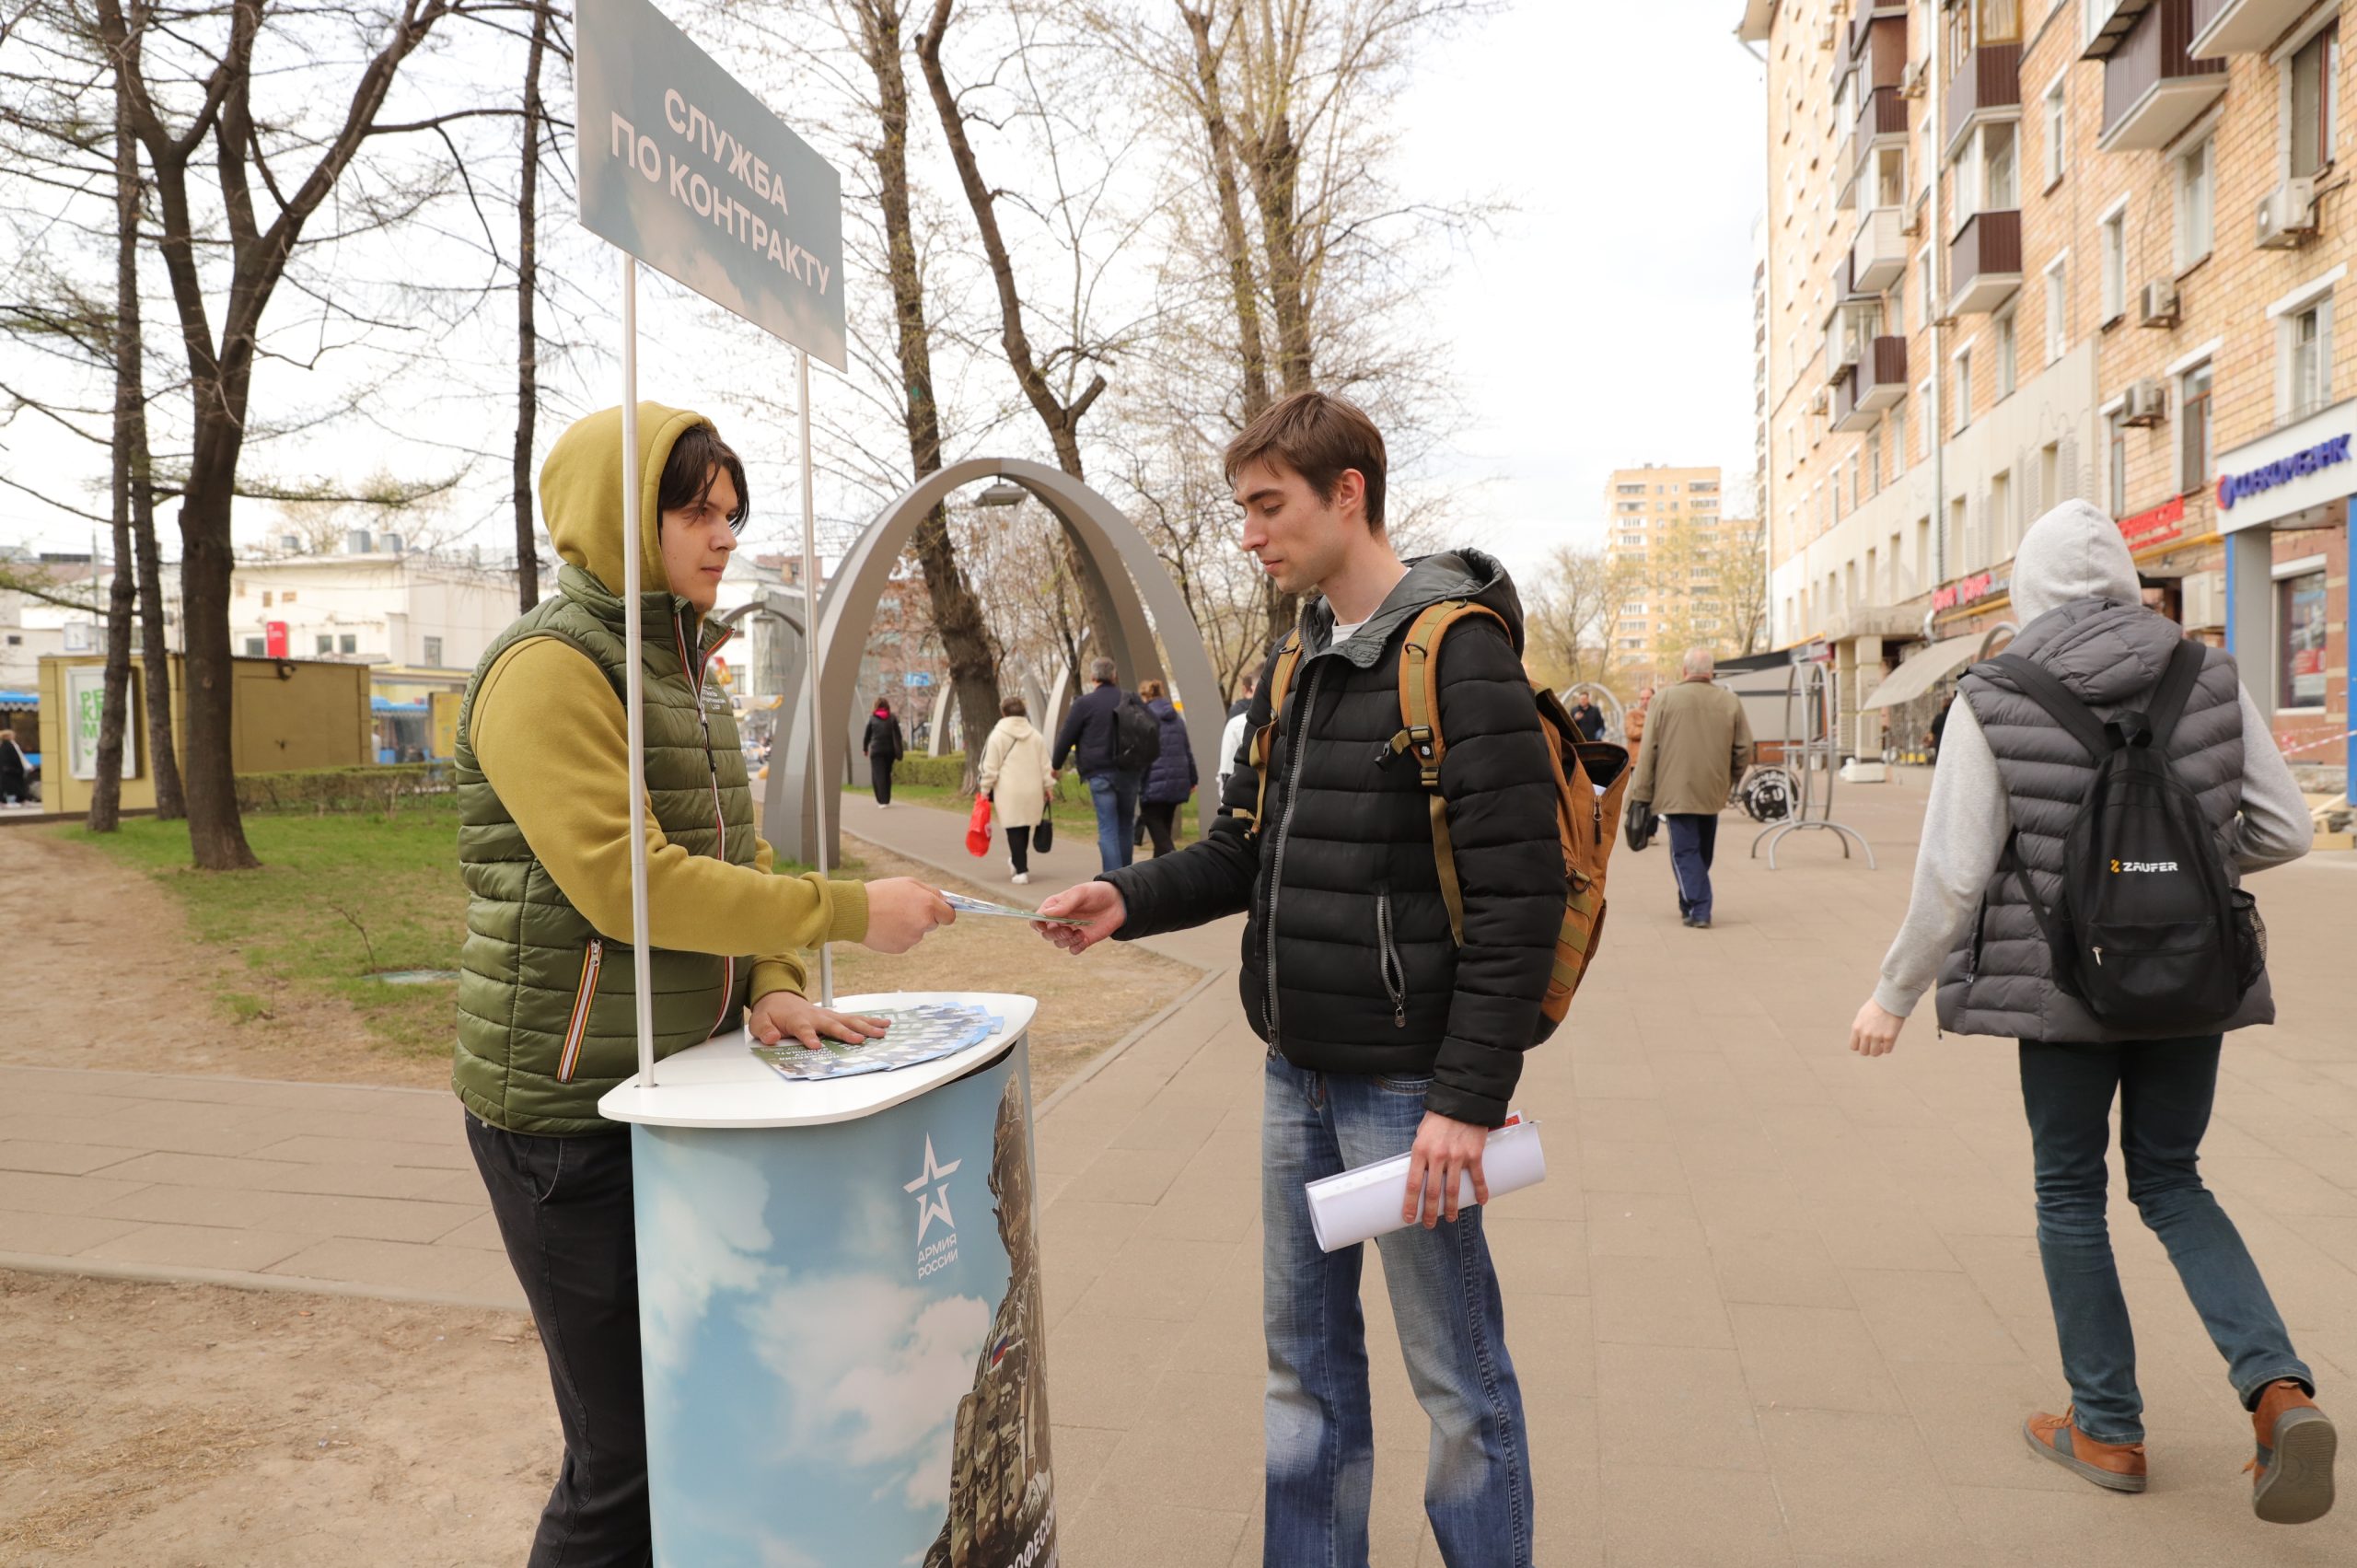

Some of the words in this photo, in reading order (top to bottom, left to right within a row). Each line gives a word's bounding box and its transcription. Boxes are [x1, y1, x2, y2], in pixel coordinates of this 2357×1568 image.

[665, 88, 789, 215] СЛУЖБА
[611, 110, 661, 182] ПО
[669, 155, 830, 295] КОНТРАКТУ
[918, 1233, 958, 1265] АРМИЯ
[918, 1249, 958, 1280] РОССИИ
